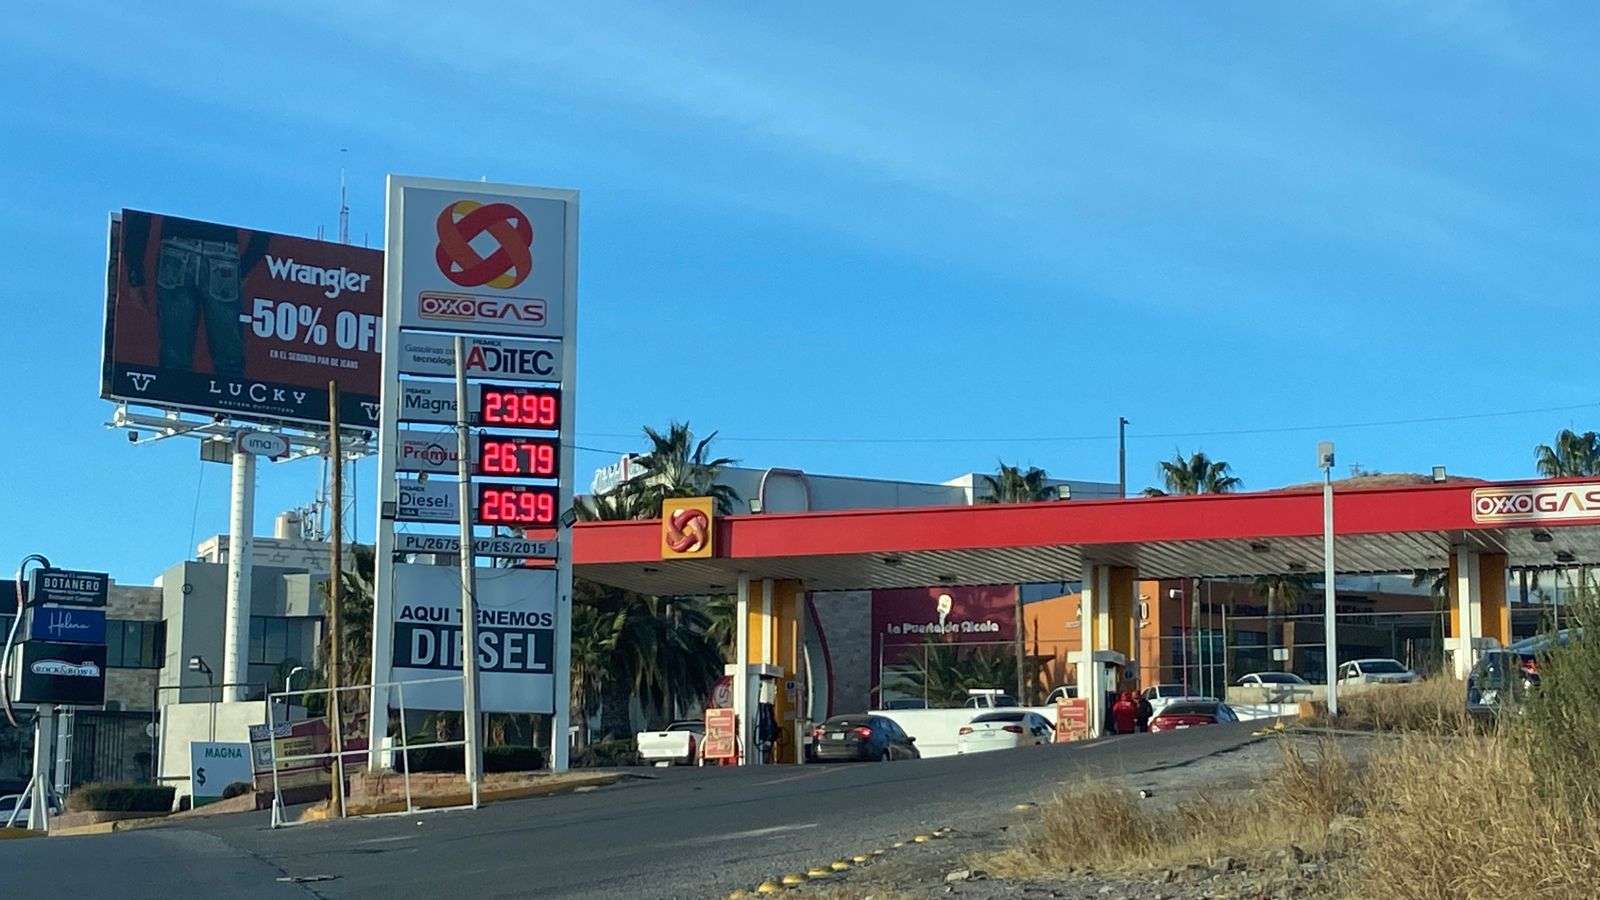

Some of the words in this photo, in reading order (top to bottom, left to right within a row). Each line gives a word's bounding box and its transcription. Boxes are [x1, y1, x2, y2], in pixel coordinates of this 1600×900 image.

[265, 254, 371, 299] Wrangler
[239, 298, 328, 346] -50%
[210, 380, 306, 404] LUCKY
[405, 395, 459, 414] Magna
[484, 392, 556, 425] 23.99
[483, 442, 554, 474] 26.79
[400, 492, 449, 508] Diesel
[482, 490, 554, 521] 26.99
[44, 577, 100, 592] BOTANERO
[400, 605, 449, 622] AQUI
[204, 748, 243, 759] MAGNA
